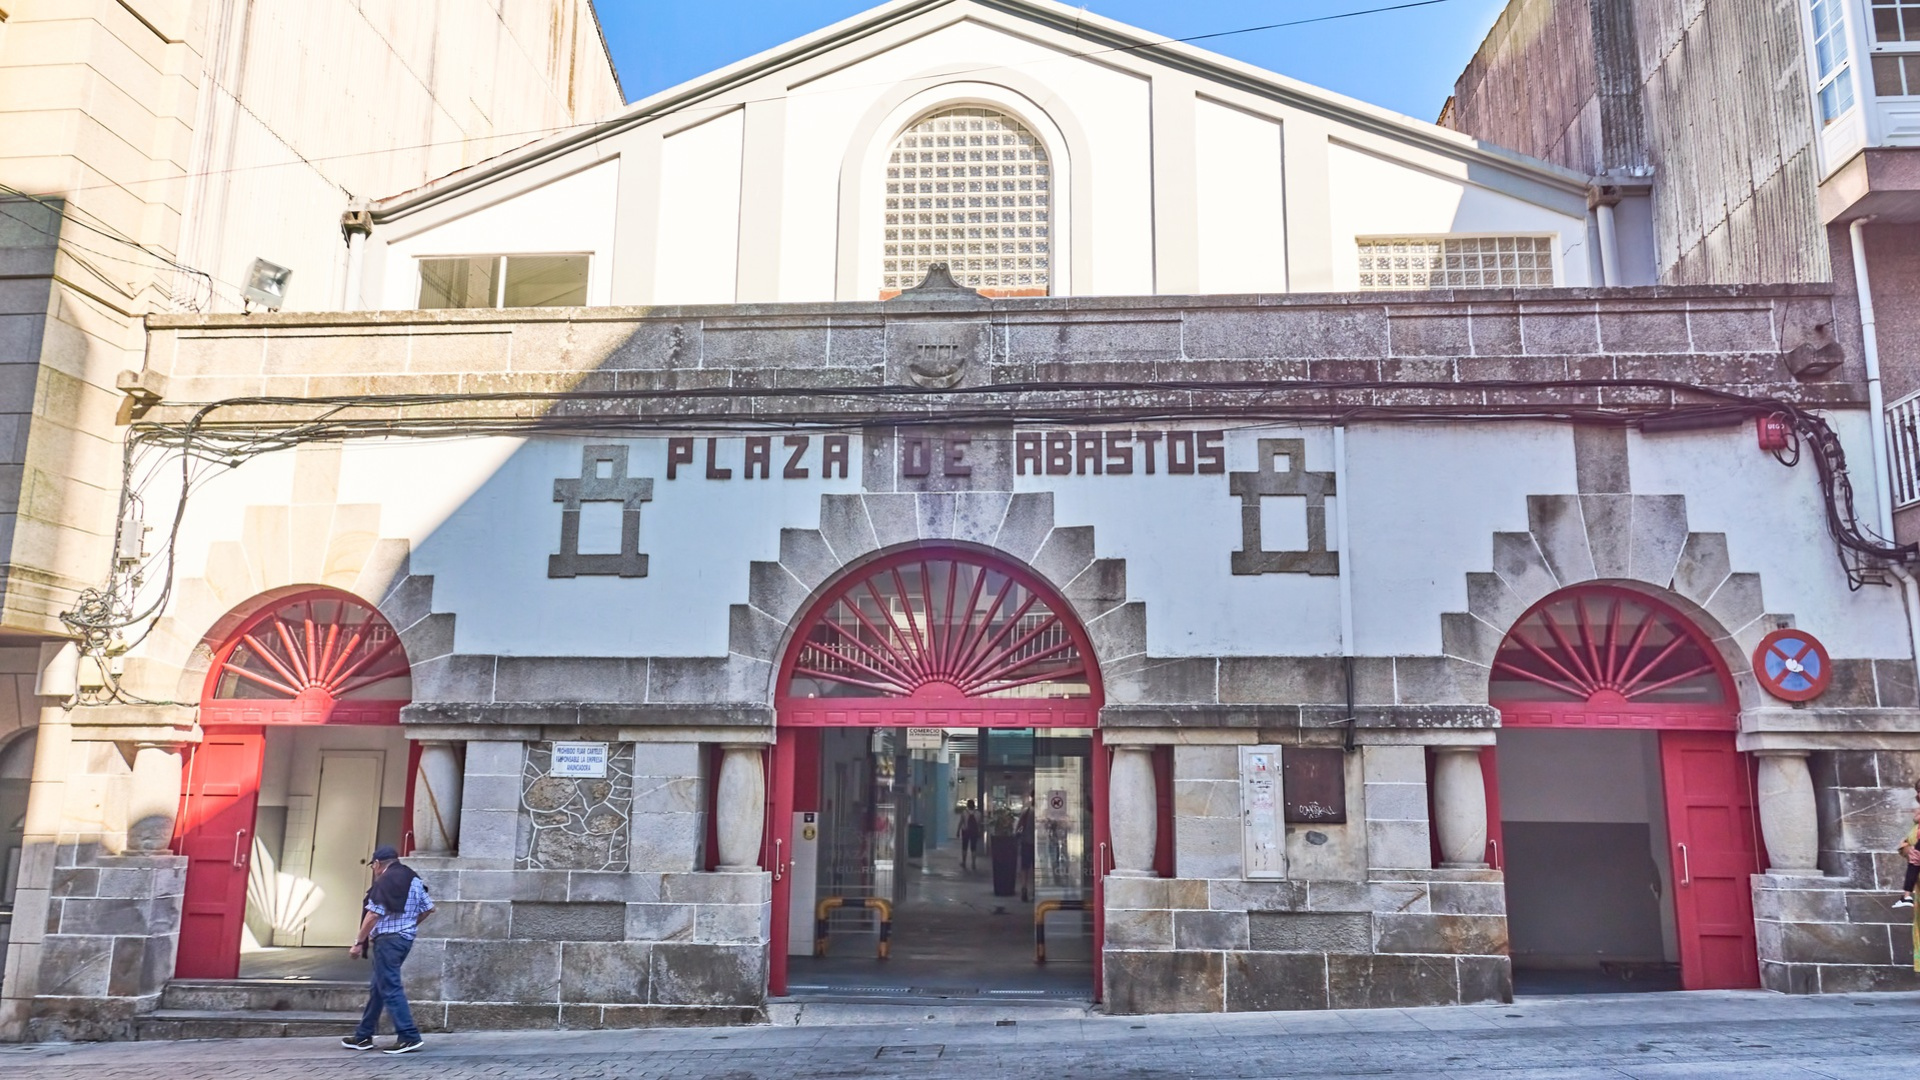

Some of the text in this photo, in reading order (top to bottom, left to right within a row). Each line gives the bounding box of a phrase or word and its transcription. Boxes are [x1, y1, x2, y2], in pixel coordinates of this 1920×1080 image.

[667, 429, 1226, 479] PLAZA DE ABASTOS
